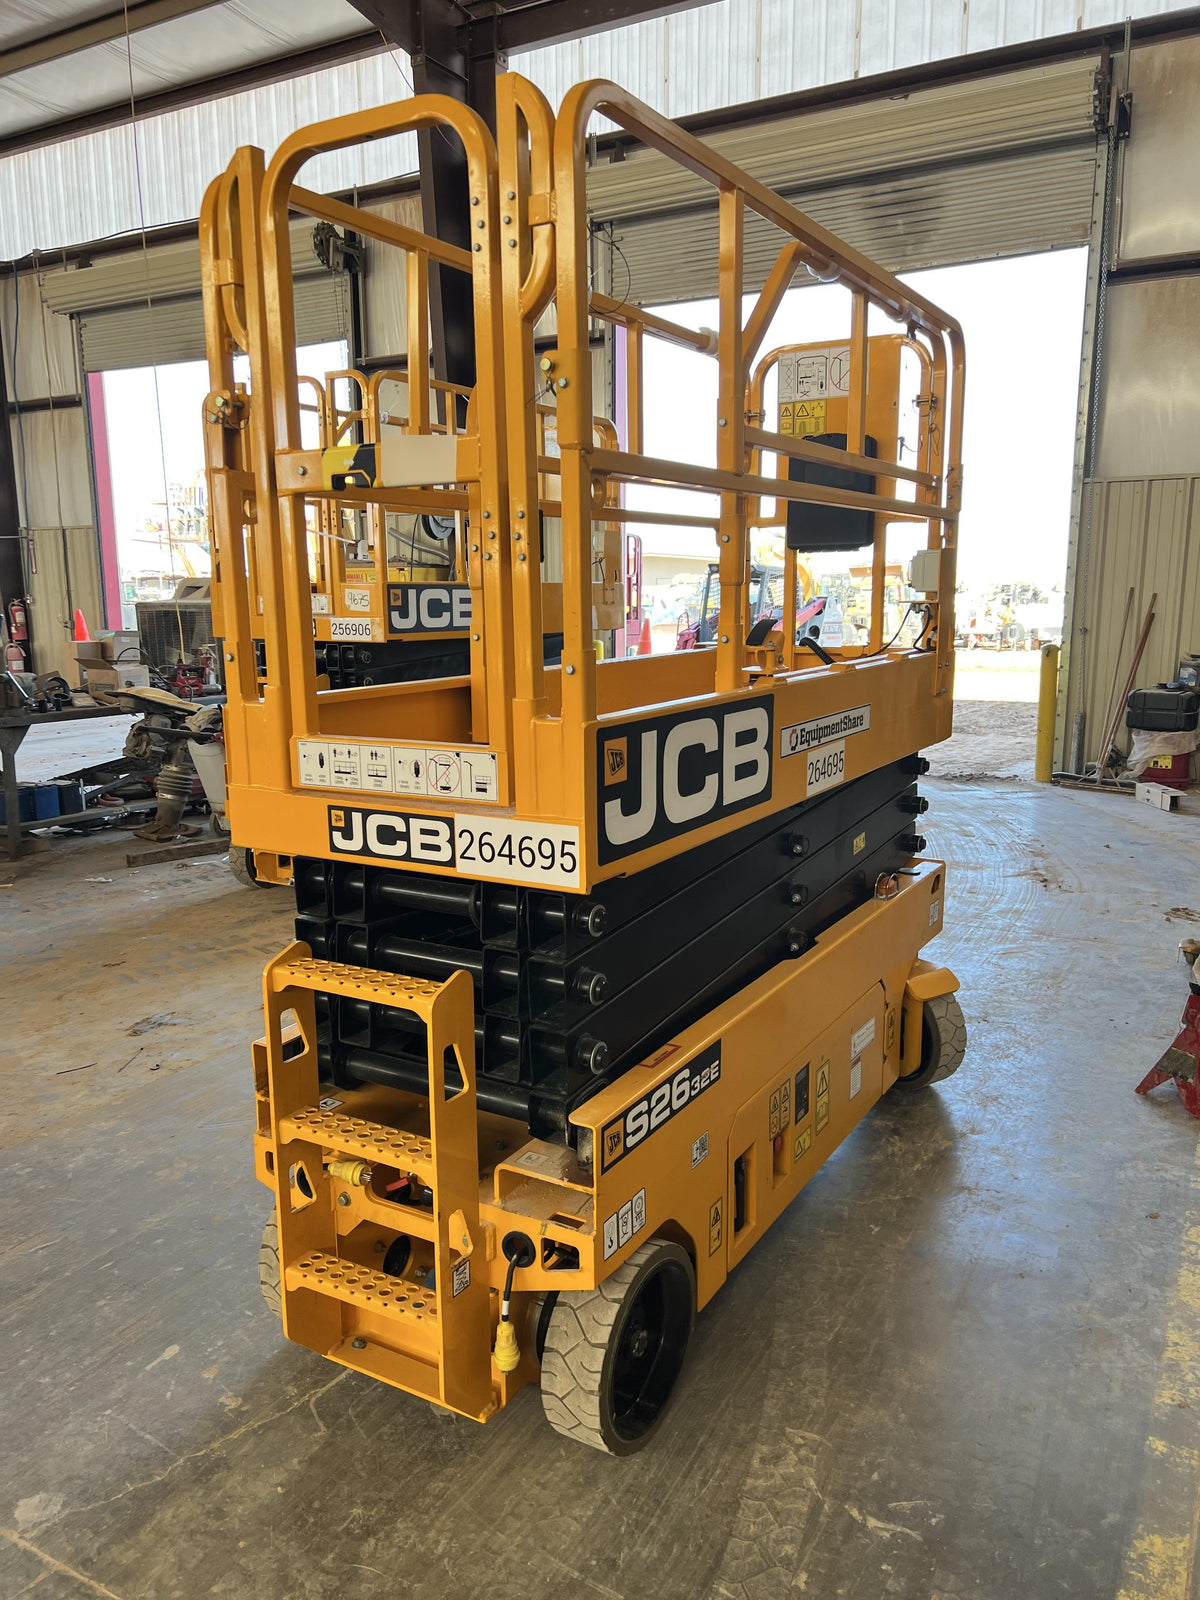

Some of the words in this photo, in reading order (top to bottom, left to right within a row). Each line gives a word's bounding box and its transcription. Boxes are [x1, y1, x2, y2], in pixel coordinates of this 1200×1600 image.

[332, 622, 371, 636] 256906
[800, 714, 864, 747] EquipmentShare
[604, 707, 769, 846] JCB
[610, 751, 624, 772] JCB
[808, 750, 844, 786] 264695
[332, 811, 452, 863] JCB
[458, 828, 577, 873] 264695
[608, 1131, 620, 1153] JCB
